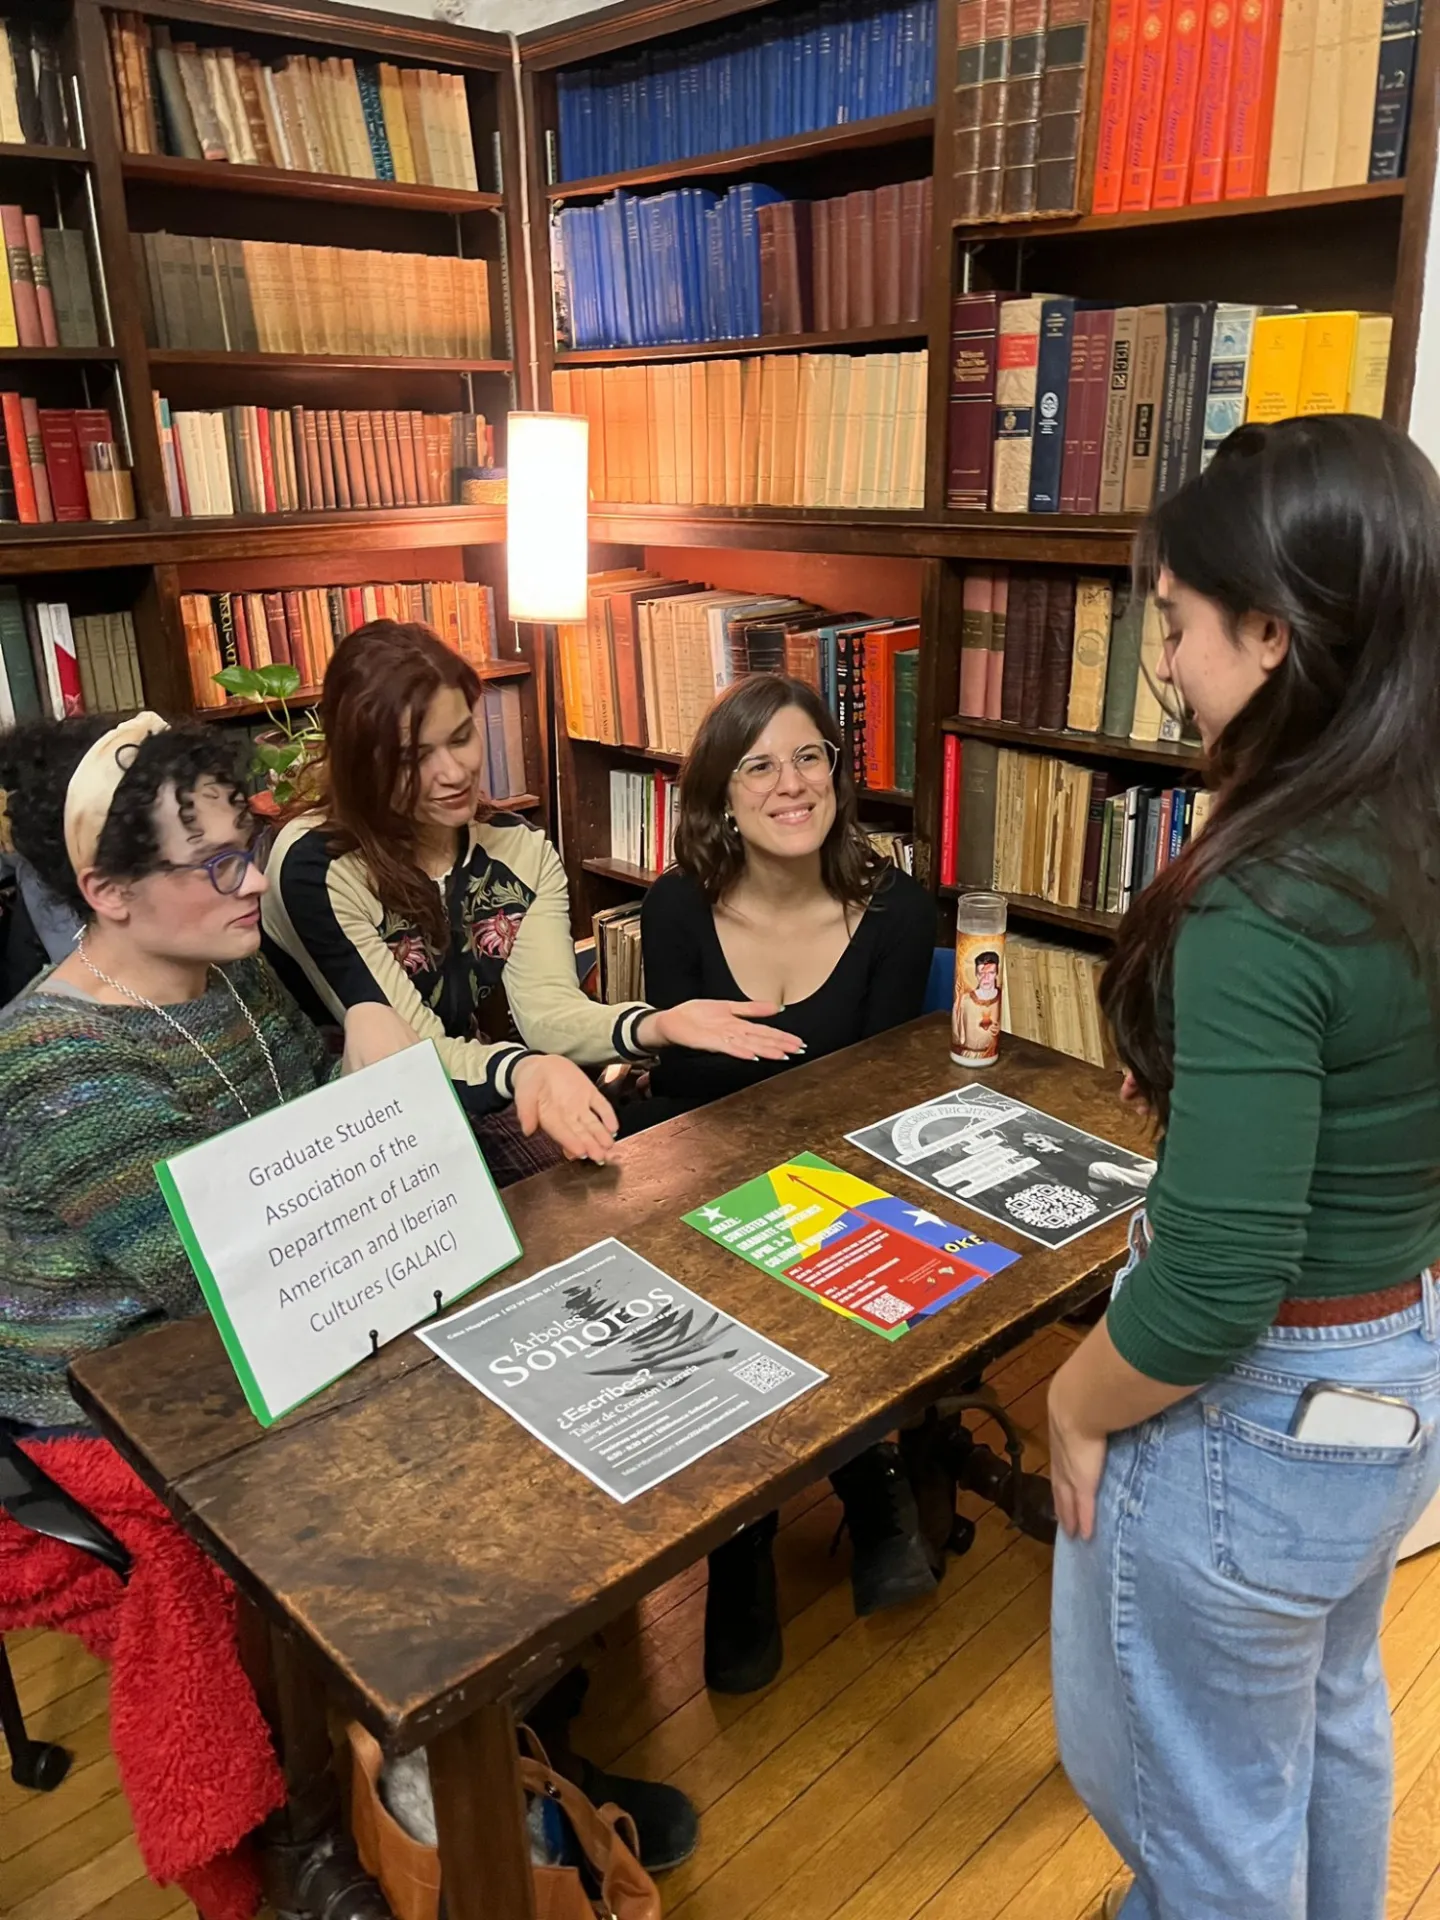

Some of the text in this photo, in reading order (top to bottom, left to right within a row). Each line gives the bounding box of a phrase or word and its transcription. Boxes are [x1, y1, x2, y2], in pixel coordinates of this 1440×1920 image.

[1113, 341, 1129, 371] TCLC
[249, 1100, 404, 1187] Graduate Student
[267, 1135, 418, 1226] Association of the
[269, 1163, 440, 1268] Department of Latin
[280, 1194, 458, 1309] American and Iberian
[723, 1218, 769, 1243] CONTESTED
[737, 1228, 780, 1252] GRADUATE
[751, 1244, 778, 1260] APRIL
[765, 1244, 806, 1268] COLUMBIA
[806, 1221, 848, 1246] UNIVERSITY
[311, 1230, 457, 1333] Cultures (GALAIC)
[447, 1331, 466, 1340] Casa
[555, 1271, 586, 1287] Columbia
[585, 1256, 617, 1272] University
[489, 1288, 674, 1388] Sonoros
[510, 1312, 587, 1357] Árboles
[557, 1369, 654, 1430] ¿Escribes?
[570, 1366, 702, 1438] Taller de Creación Literaria
